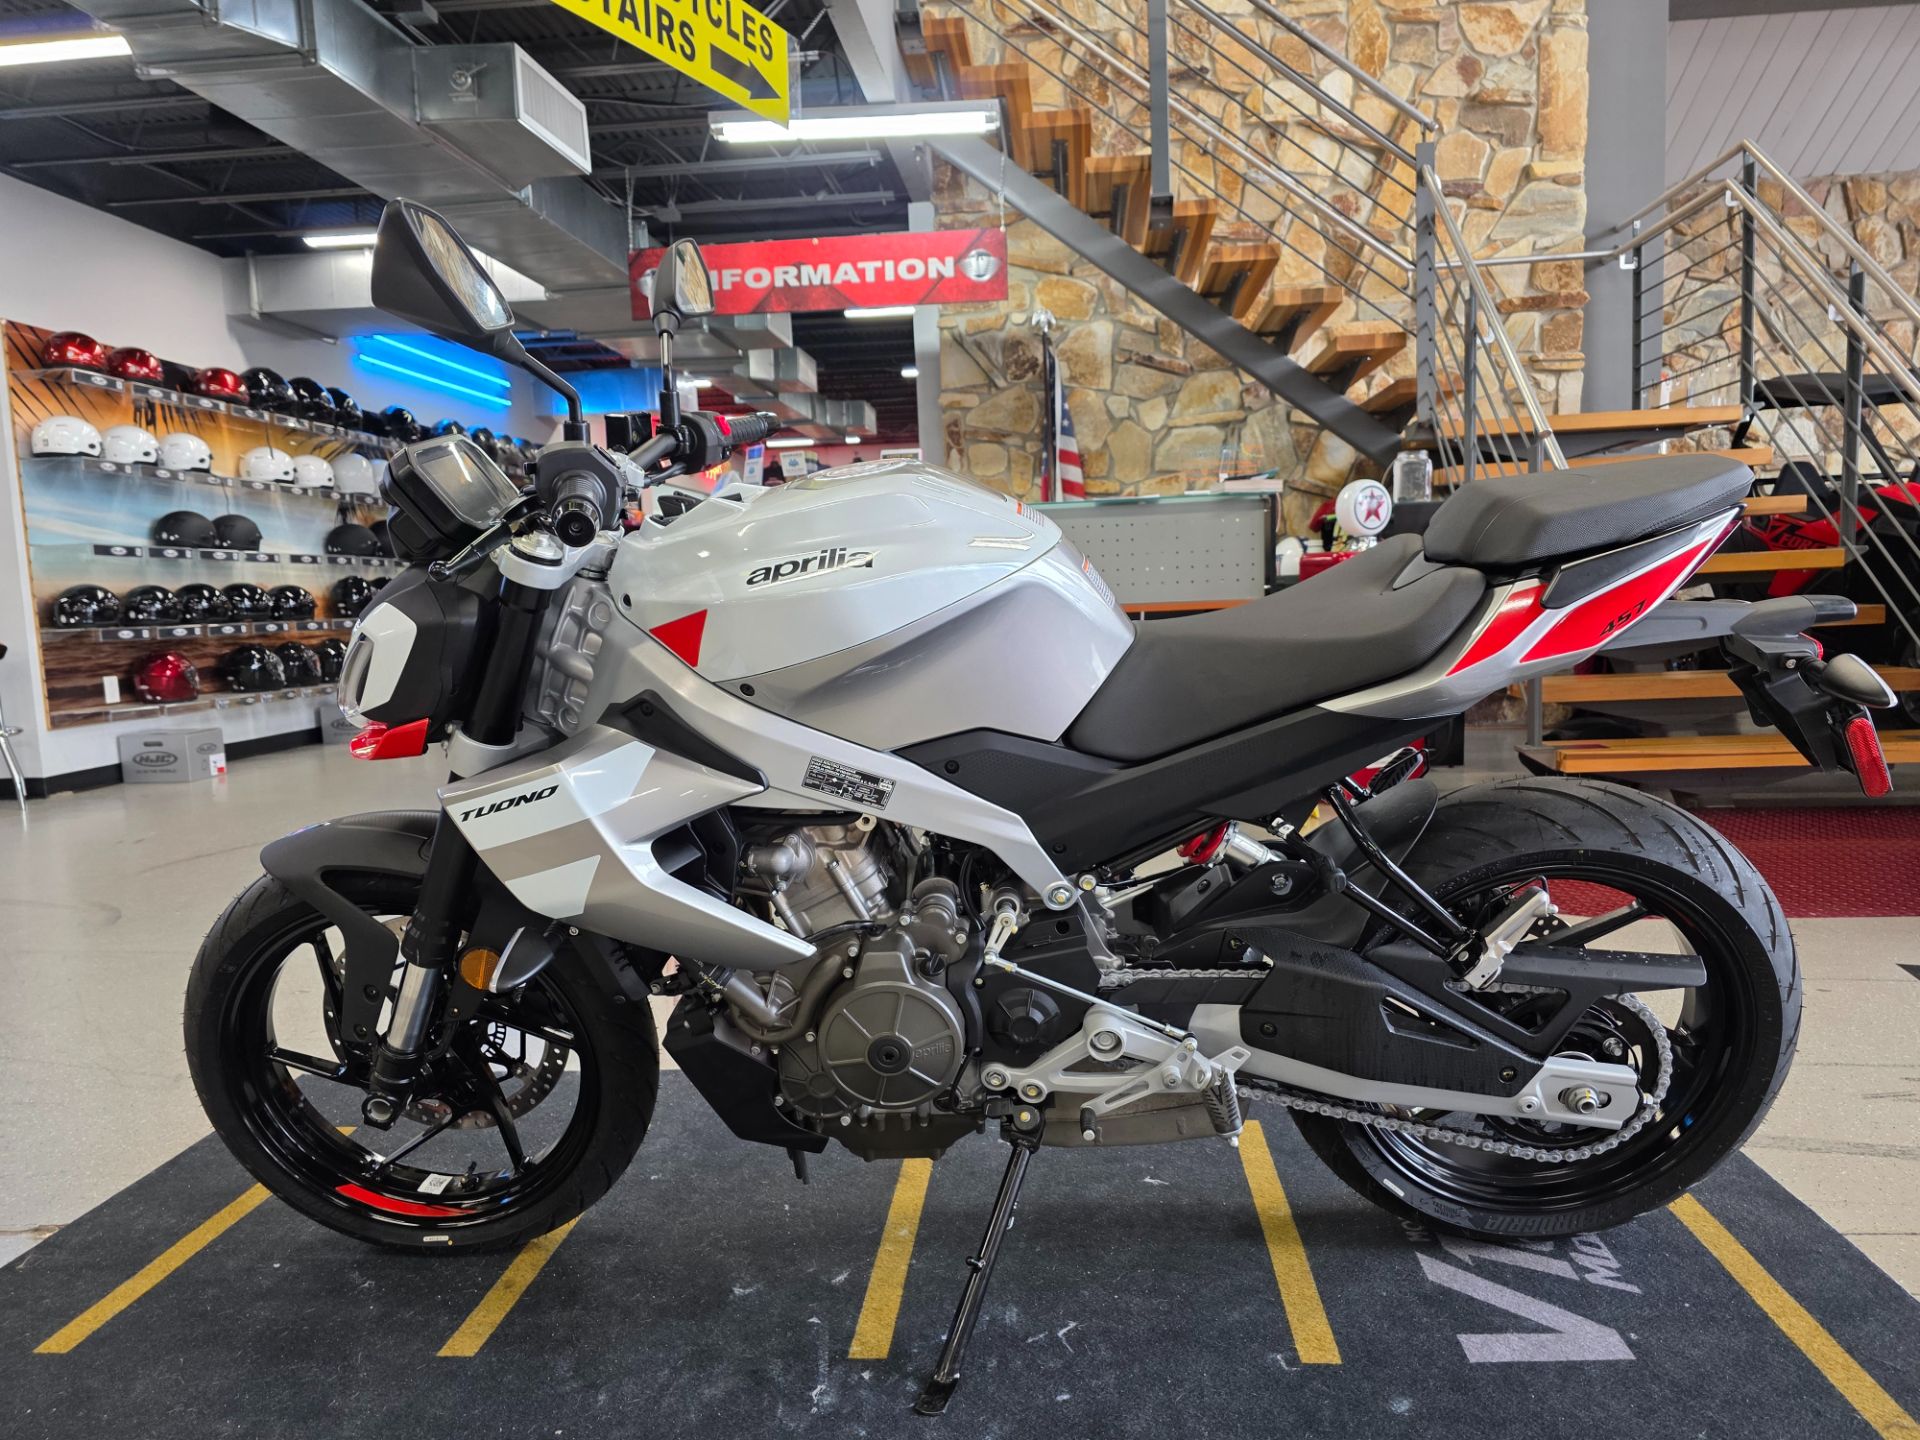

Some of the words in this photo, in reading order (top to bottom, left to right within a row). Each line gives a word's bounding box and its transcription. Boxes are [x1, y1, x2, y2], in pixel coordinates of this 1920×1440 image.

[673, 0, 773, 62] CLES
[746, 547, 874, 585] aprilia
[1599, 599, 1647, 637] 457
[139, 754, 172, 764] HJC
[460, 784, 559, 822] TUONO
